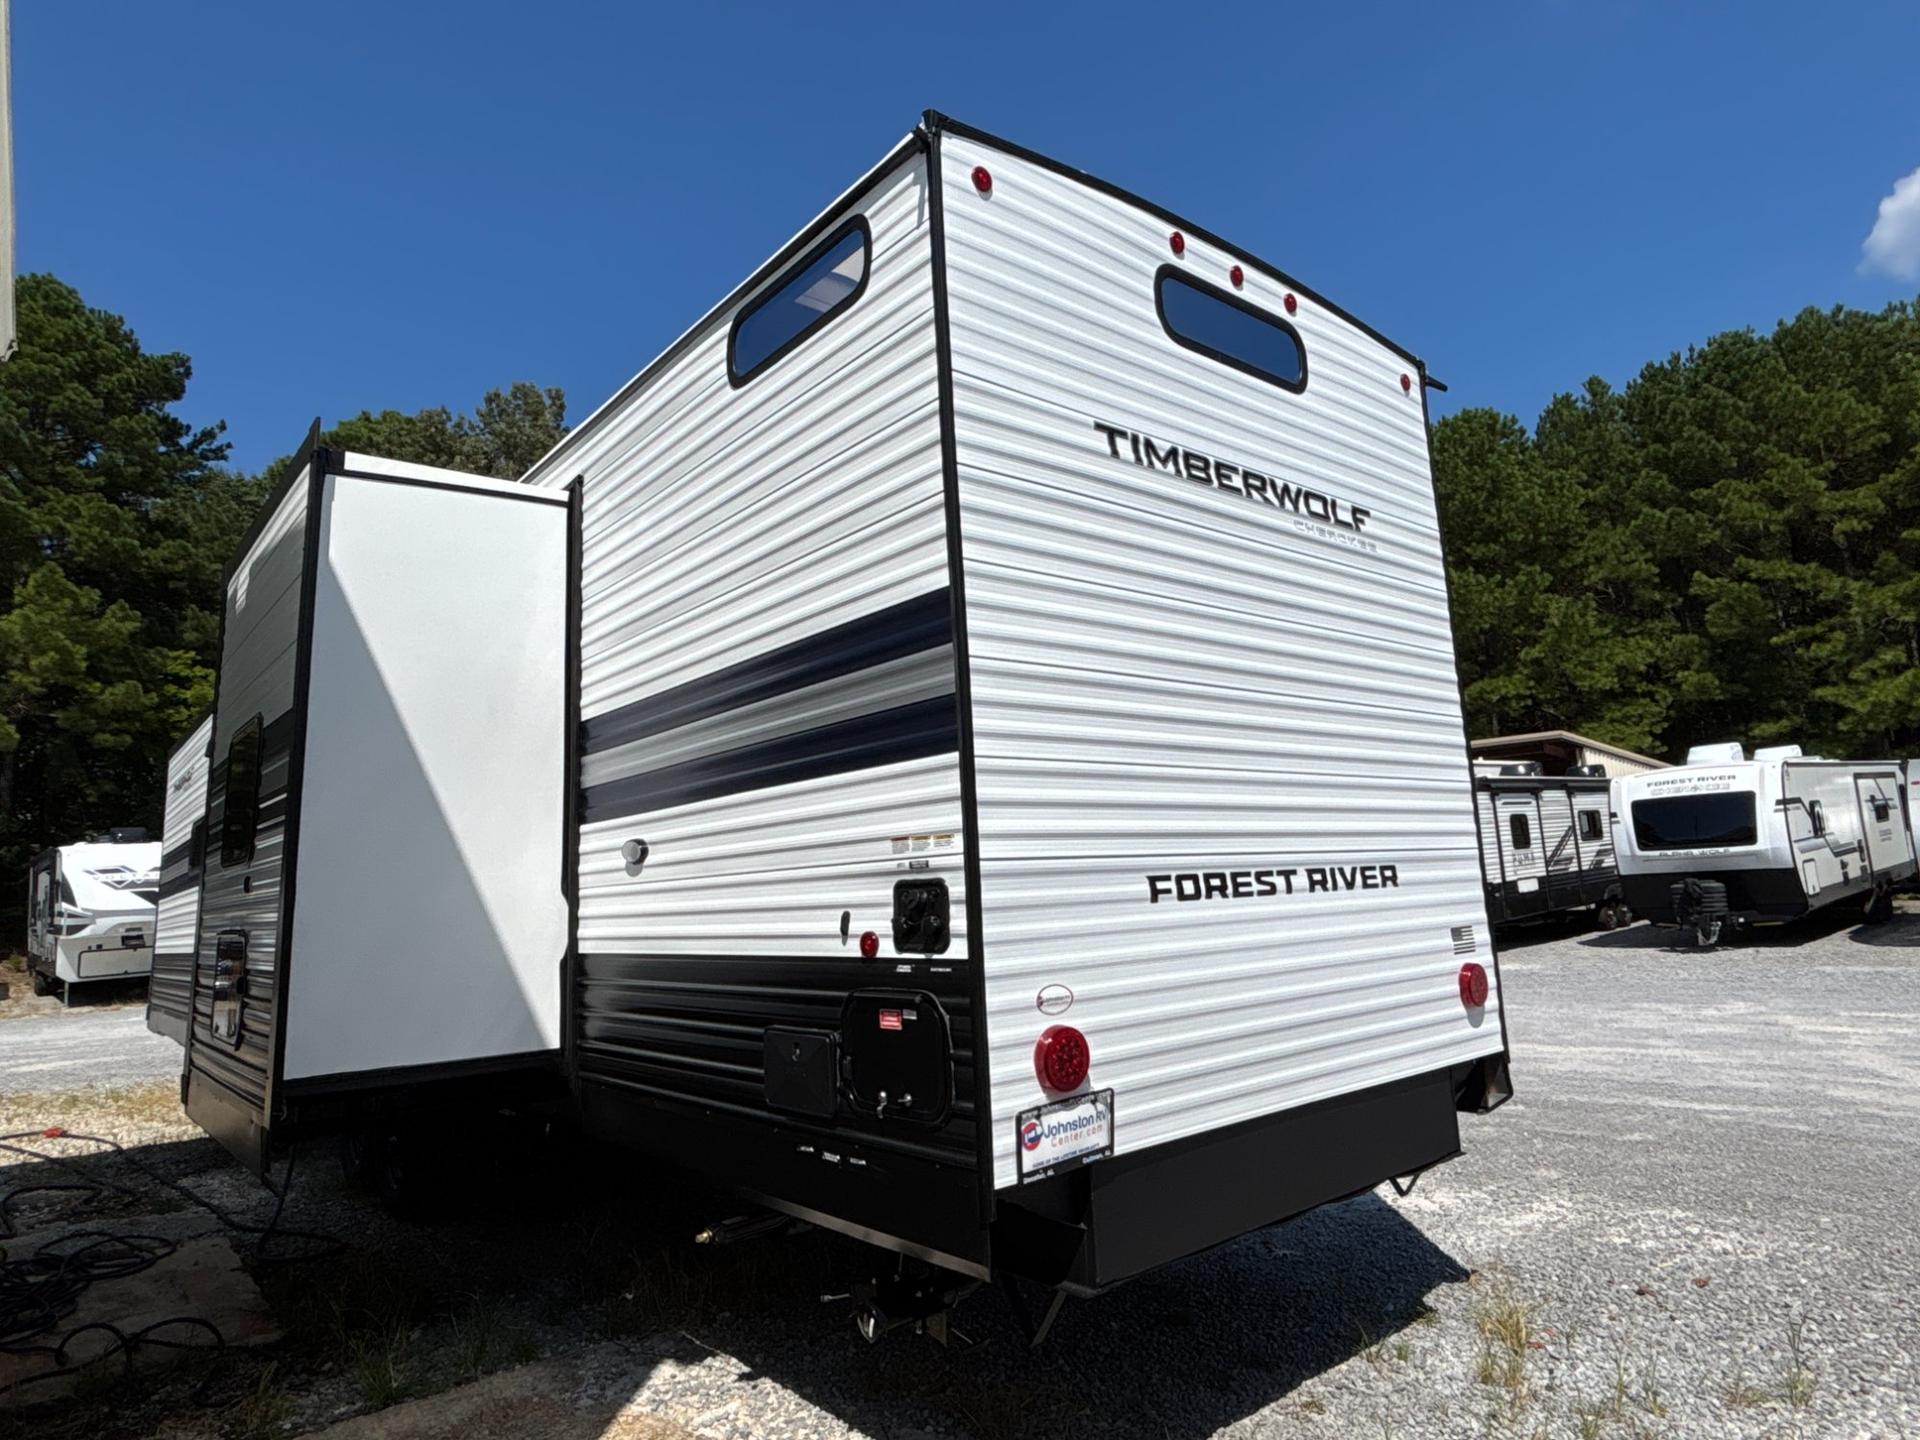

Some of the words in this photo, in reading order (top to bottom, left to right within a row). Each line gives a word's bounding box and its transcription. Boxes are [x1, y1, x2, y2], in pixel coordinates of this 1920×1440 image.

[1093, 420, 1370, 532] TIMBERWOLF
[1646, 777, 1694, 787] FOREST
[1146, 869, 1298, 903] FOREST
[1304, 865, 1399, 893] RIVER
[1044, 1114, 1094, 1138] Johnston
[1051, 1124, 1103, 1148] Center.com
